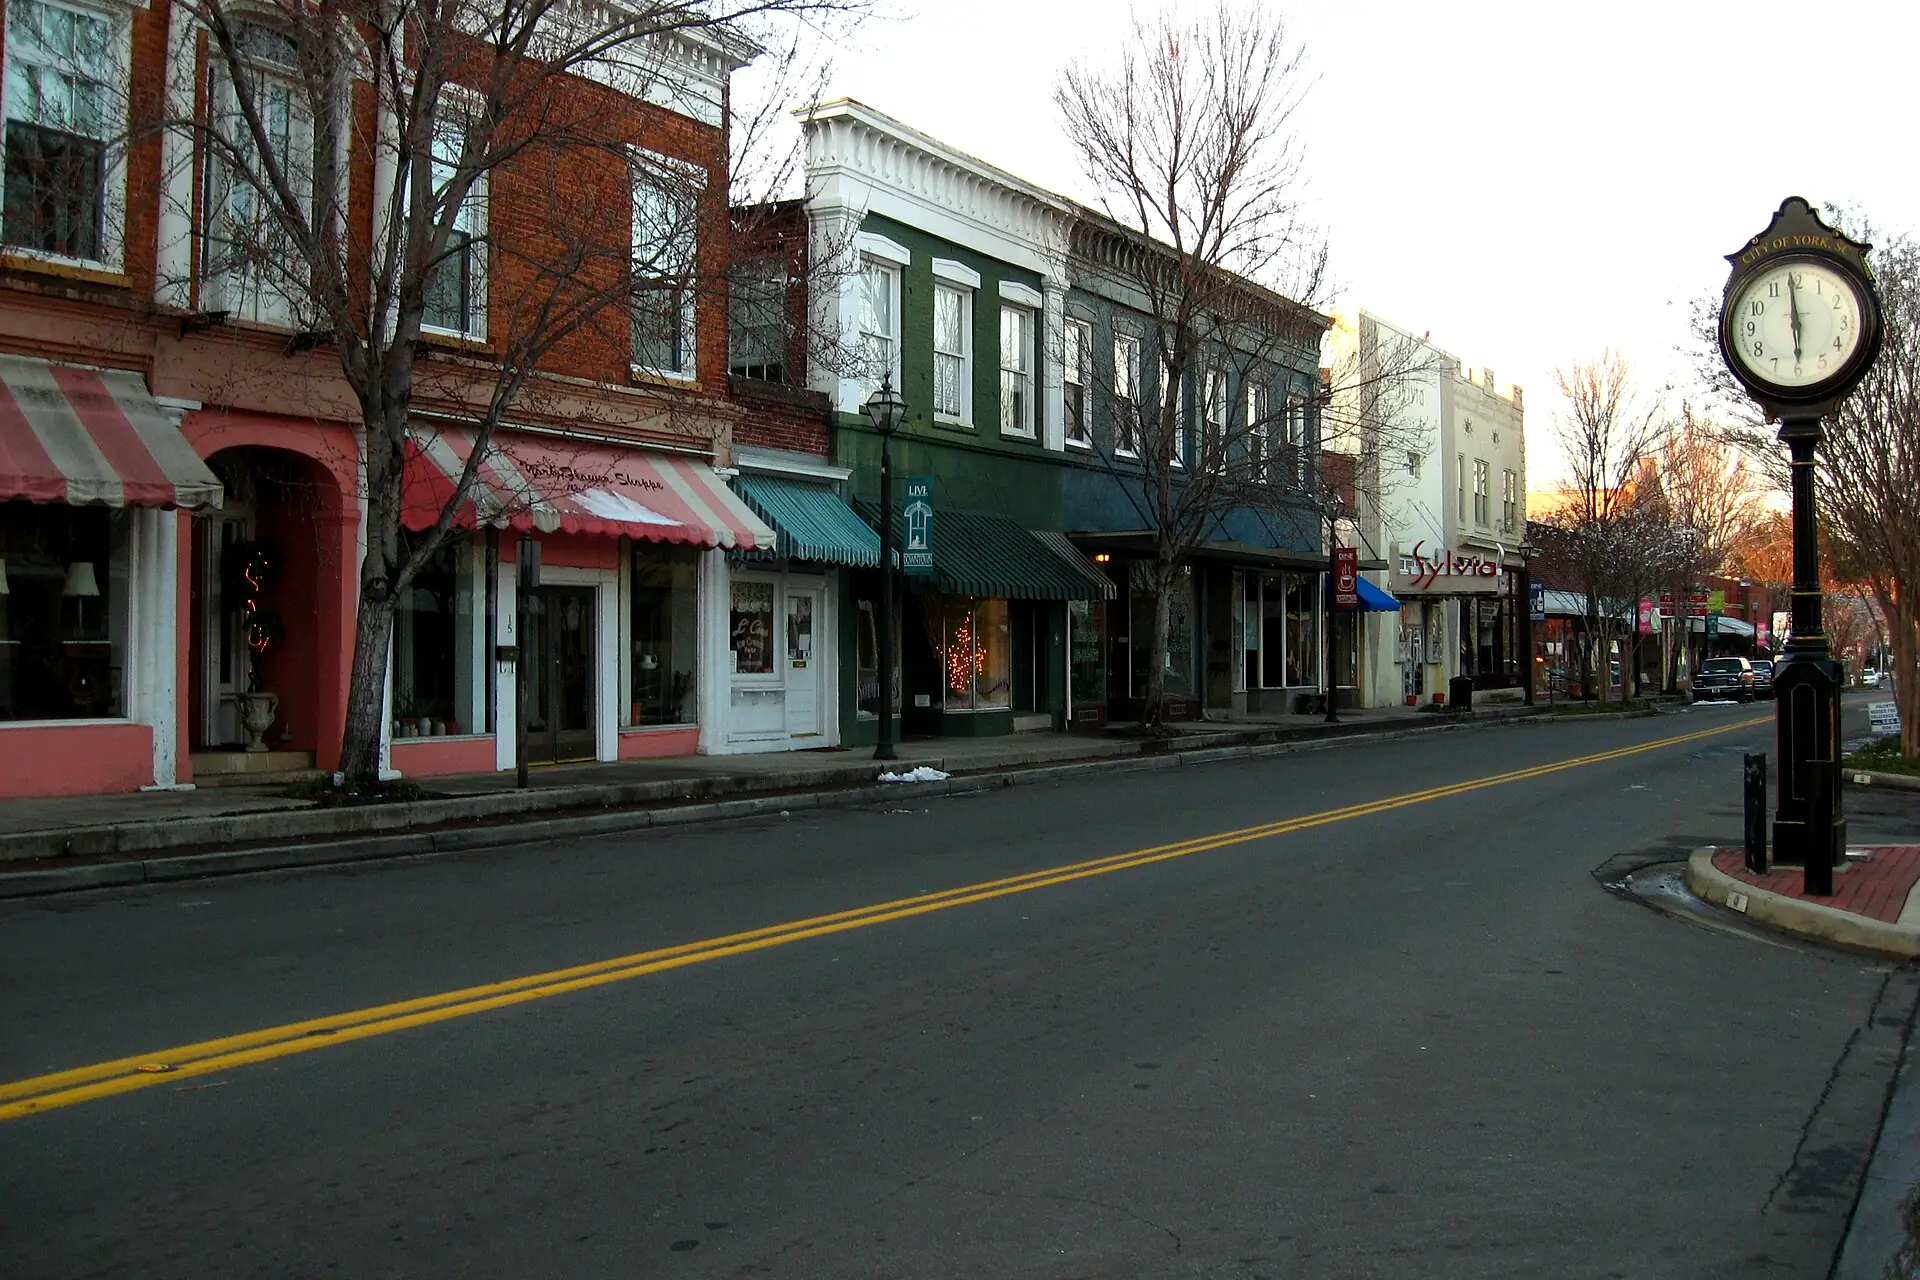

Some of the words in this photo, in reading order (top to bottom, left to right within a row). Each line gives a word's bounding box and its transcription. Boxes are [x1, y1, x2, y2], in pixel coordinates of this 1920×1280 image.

[1741, 242, 1769, 264] CITY
[1772, 236, 1789, 249] OF
[1792, 235, 1831, 249] YORK,
[1834, 241, 1851, 255] SC
[1769, 283, 1779, 297] 11
[1815, 280, 1822, 294] 1
[1750, 301, 1764, 316] 10
[1831, 295, 1841, 310] 2
[1746, 322, 1755, 336] 9
[1840, 315, 1848, 331] 3
[1753, 341, 1763, 357] 8
[1833, 336, 1842, 352] 4
[1770, 358, 1778, 372] 7
[1794, 361, 1802, 377] 6
[1818, 353, 1827, 369] 5
[614, 473, 664, 492] Shoppe
[908, 485, 928, 496] LIVE
[1408, 540, 1497, 590] Sylvia
